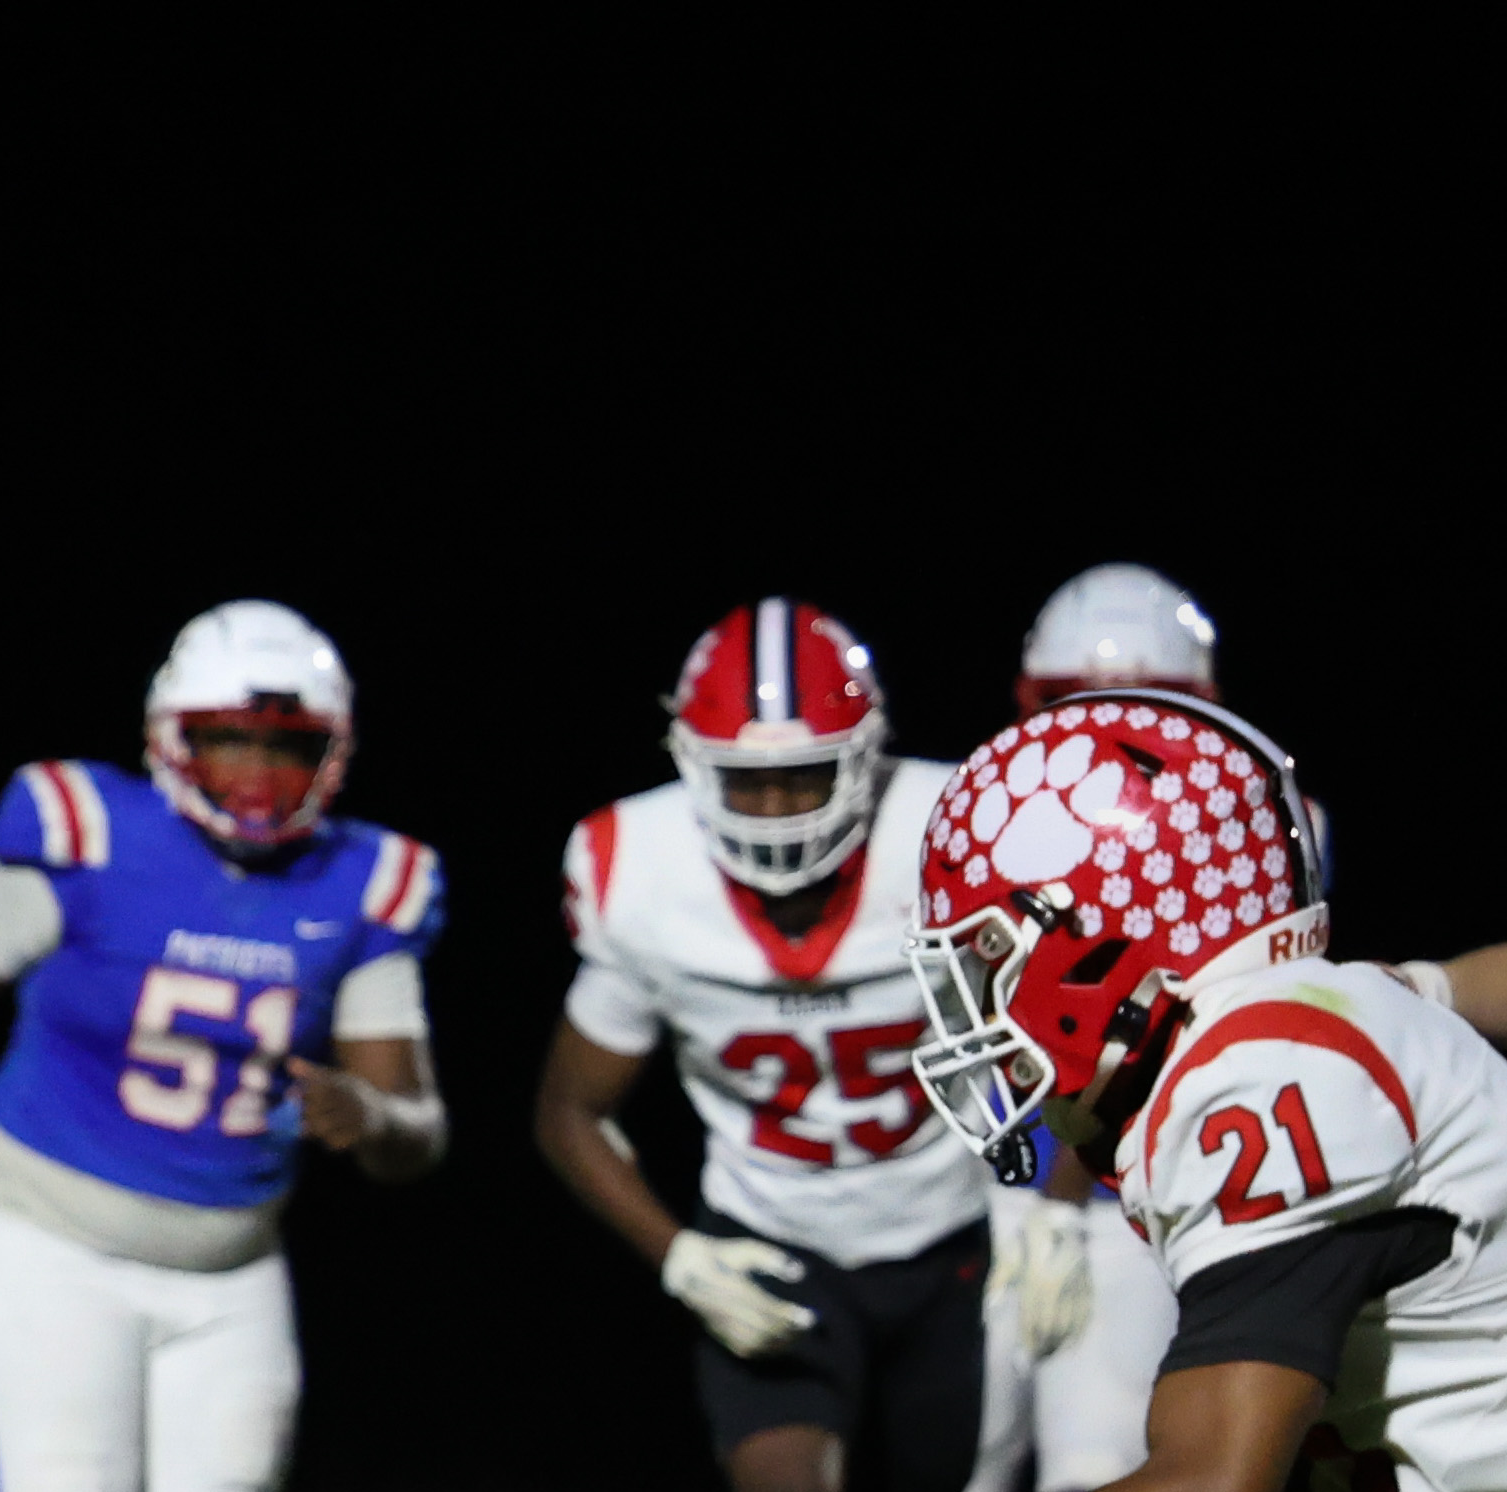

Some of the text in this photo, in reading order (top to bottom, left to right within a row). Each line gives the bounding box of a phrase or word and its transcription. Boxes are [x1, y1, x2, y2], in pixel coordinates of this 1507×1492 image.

[117, 962, 299, 1138] 51
[720, 1018, 932, 1167] 25
[1198, 1080, 1332, 1226] 21
